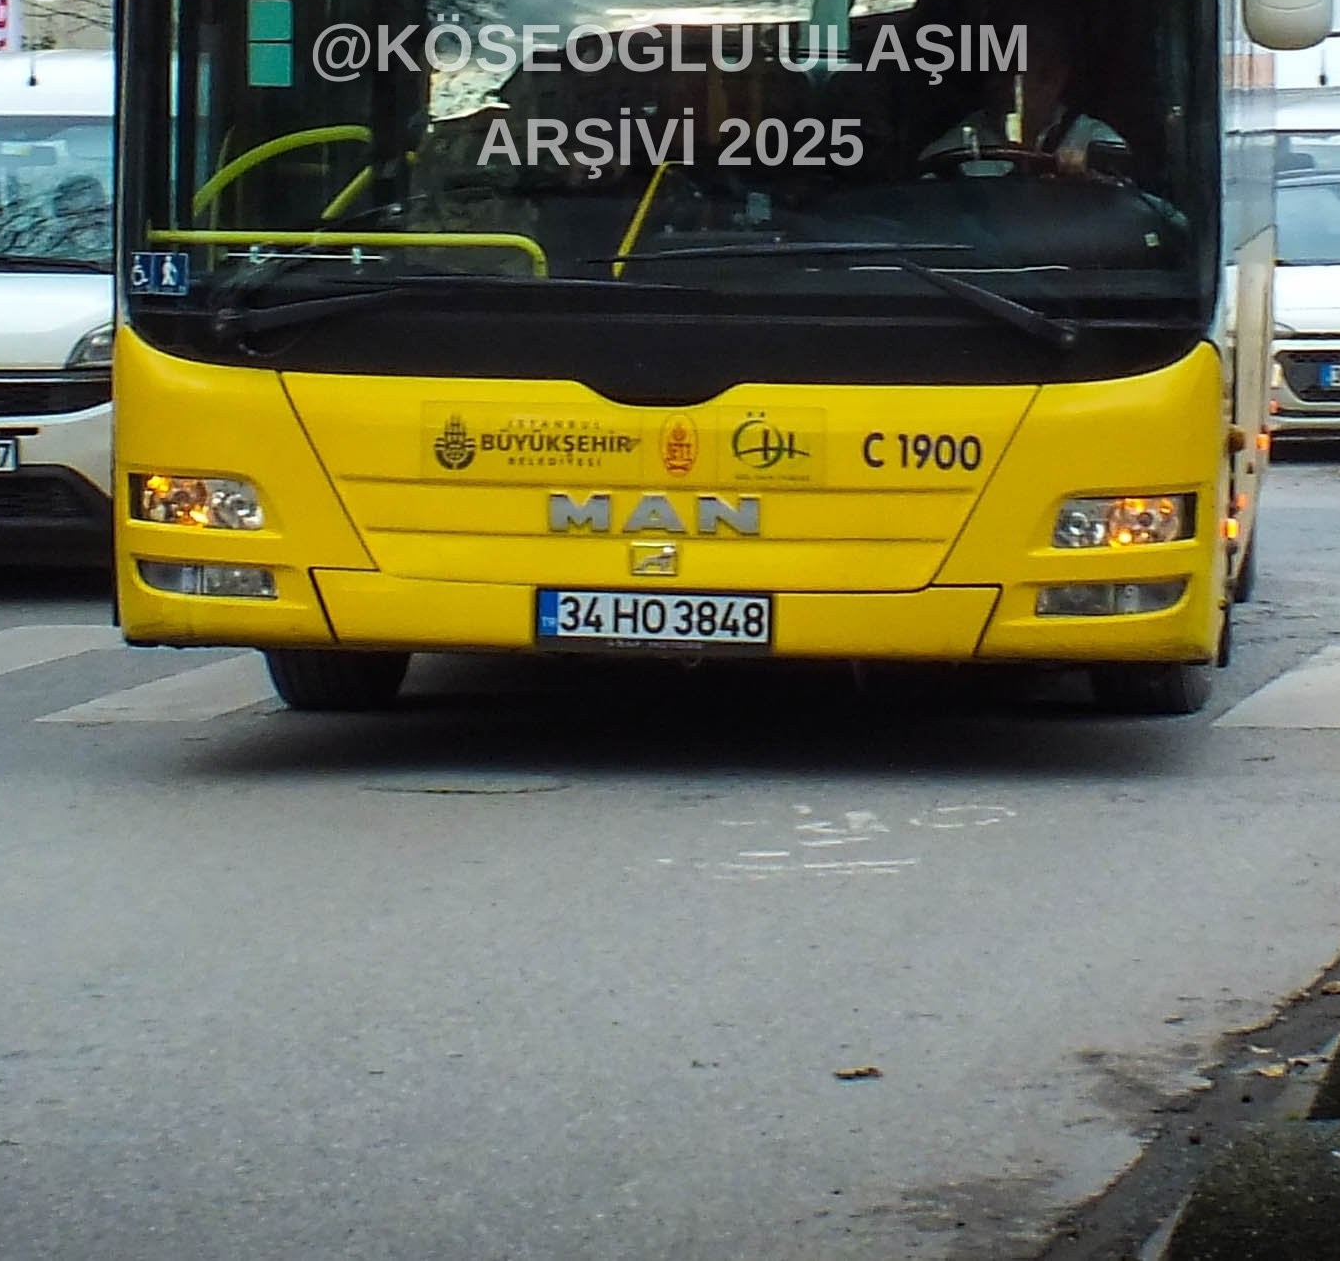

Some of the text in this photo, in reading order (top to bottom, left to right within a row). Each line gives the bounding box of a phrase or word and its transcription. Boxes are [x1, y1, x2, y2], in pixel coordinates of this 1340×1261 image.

[480, 429, 634, 456] BÜYÜKŞEHİR
[863, 432, 982, 471] C 1900
[549, 491, 762, 536] MAN
[559, 596, 604, 633] 34
[613, 597, 666, 635] HO
[673, 600, 765, 638] 3848
